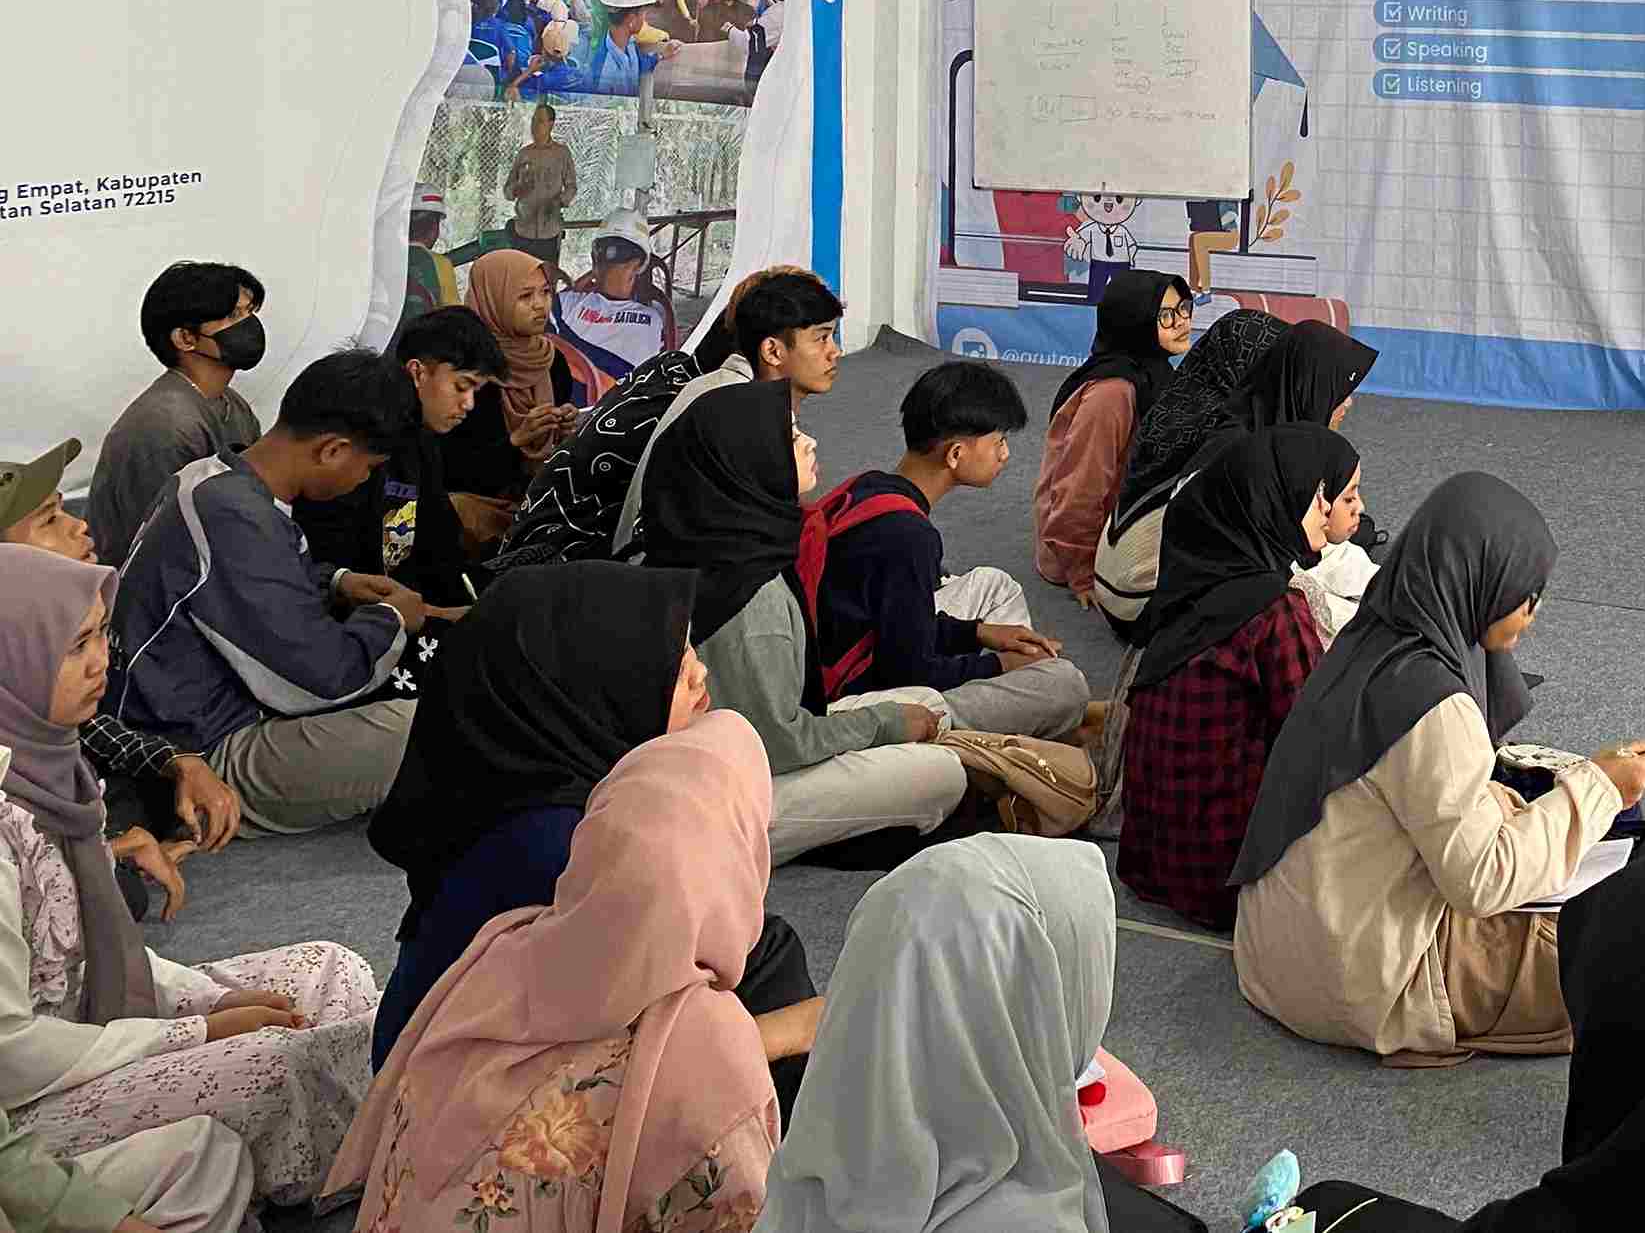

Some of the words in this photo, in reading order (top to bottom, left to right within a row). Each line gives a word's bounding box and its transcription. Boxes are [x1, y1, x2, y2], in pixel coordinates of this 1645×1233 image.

[1407, 6, 1468, 25] Writing
[1407, 42, 1488, 63] Speaking
[1407, 78, 1482, 99] Listening
[17, 180, 89, 199] Empat,
[96, 171, 201, 193] Kabupaten
[40, 196, 116, 215] Selatan
[124, 189, 175, 207] 72215
